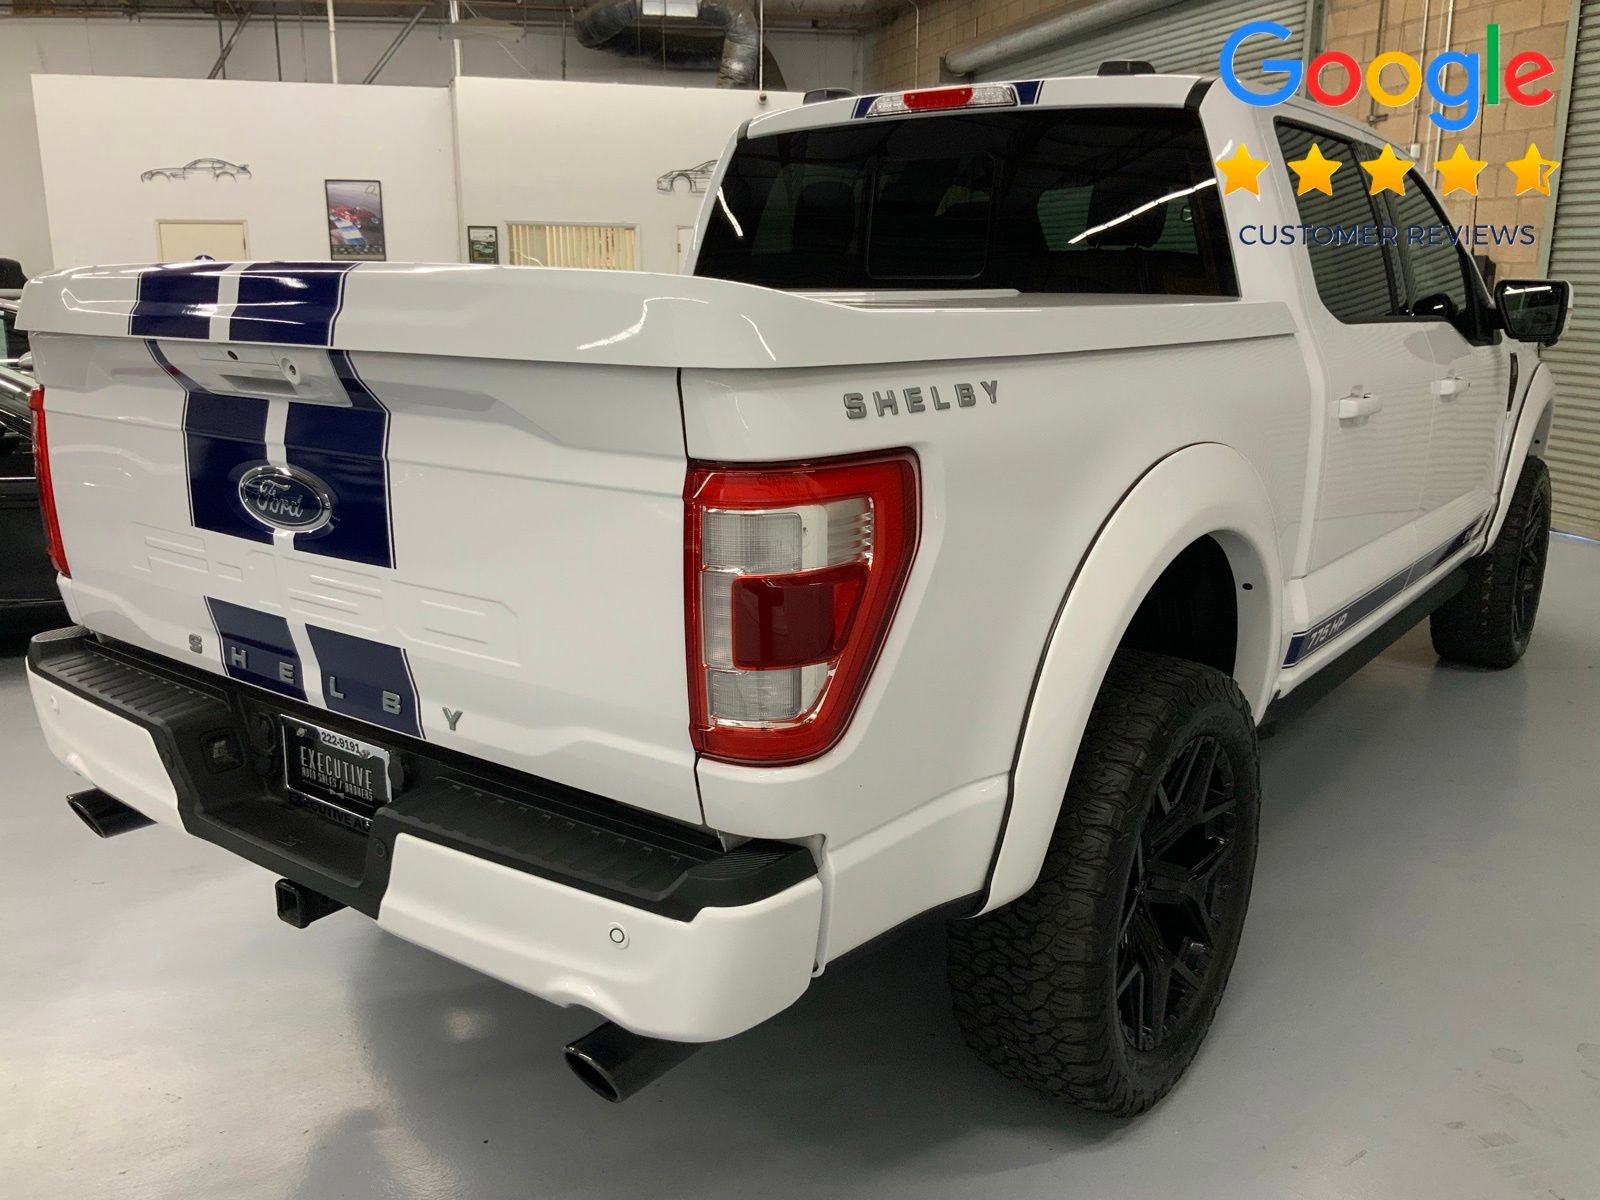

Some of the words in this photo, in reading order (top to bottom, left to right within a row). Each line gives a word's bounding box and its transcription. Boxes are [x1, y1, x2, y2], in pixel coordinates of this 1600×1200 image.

[843, 380, 998, 419] SHELBY
[256, 480, 305, 518] Ford
[188, 633, 463, 731] SHELBY
[321, 732, 360, 754] 222-9191
[300, 746, 373, 790] EXECUTIVE
